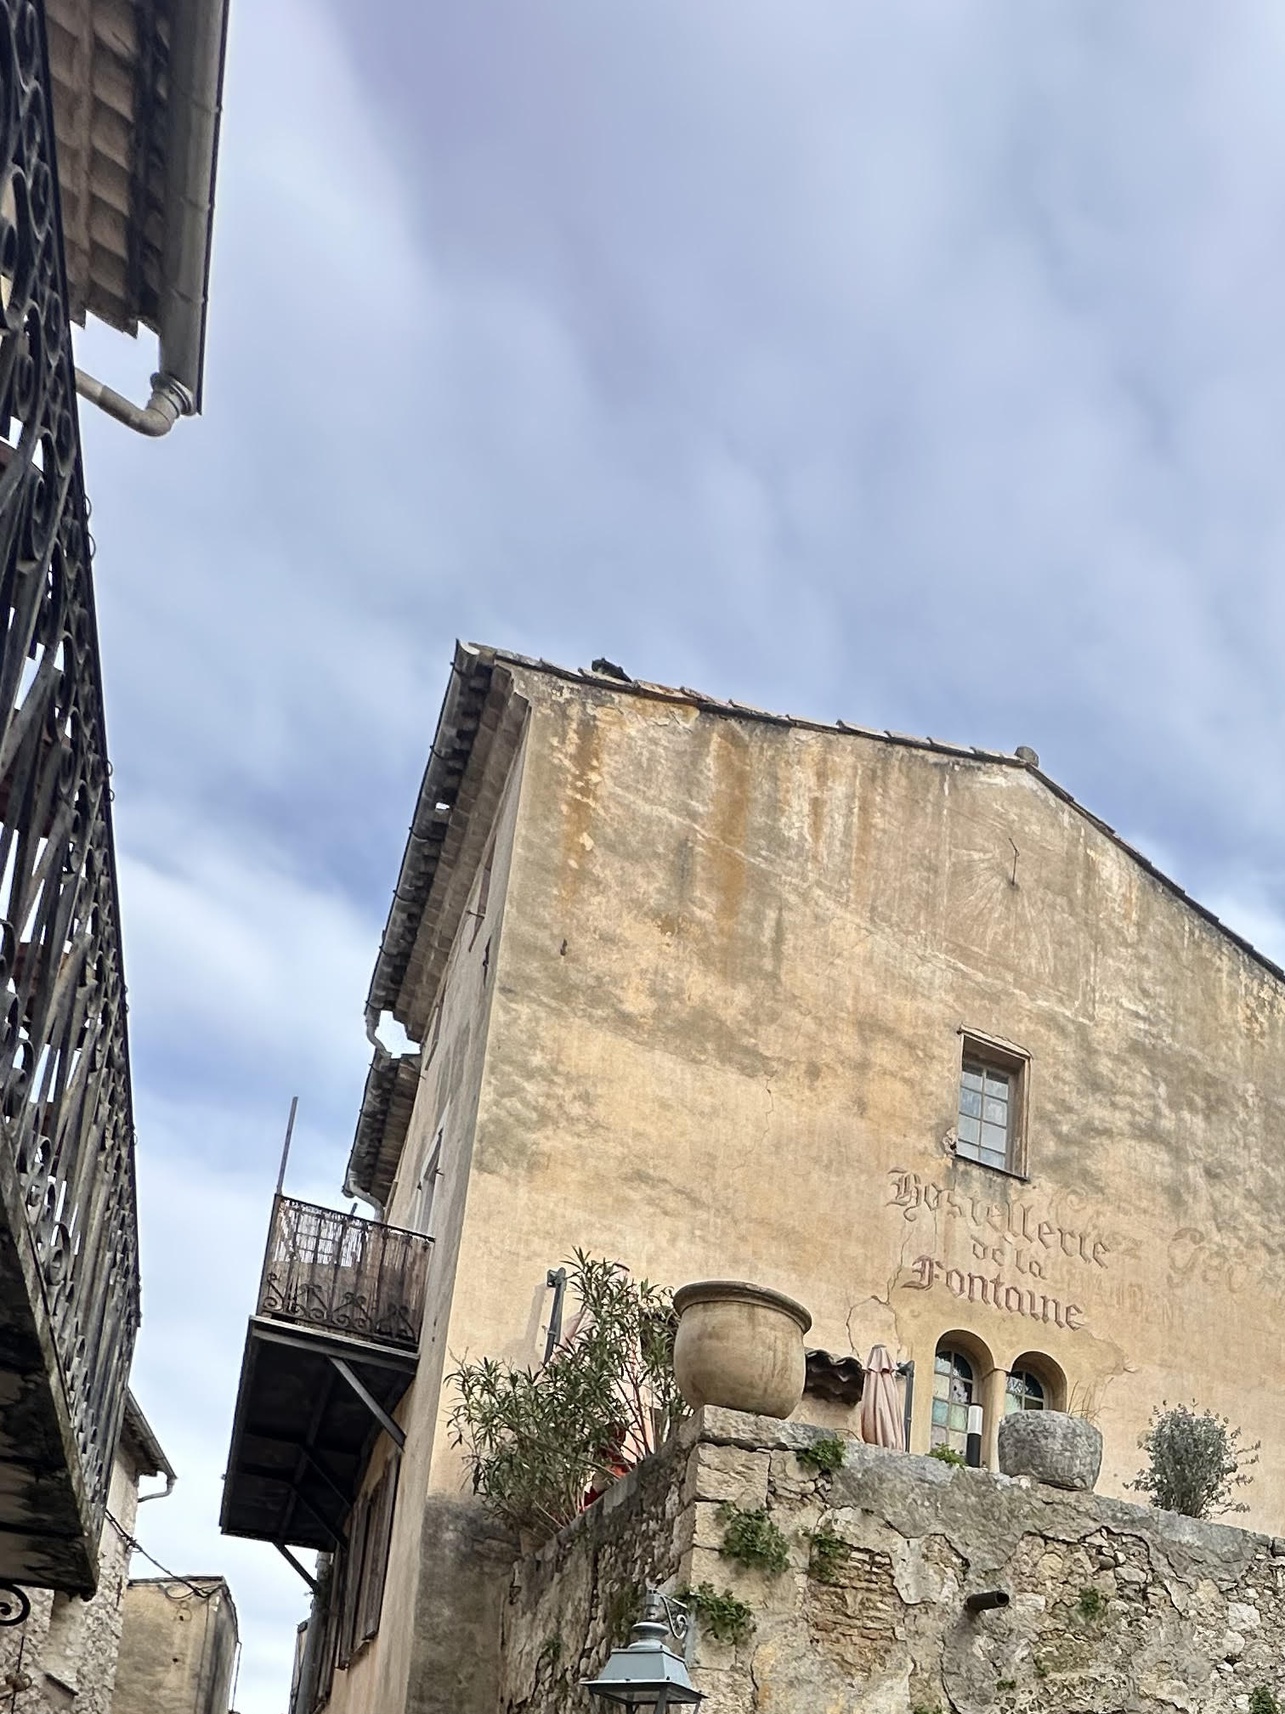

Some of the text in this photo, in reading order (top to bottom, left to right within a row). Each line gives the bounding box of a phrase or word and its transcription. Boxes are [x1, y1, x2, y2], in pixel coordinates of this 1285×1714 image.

[971, 1235, 1047, 1280] de la
[901, 1255, 1085, 1332] Fontaine
